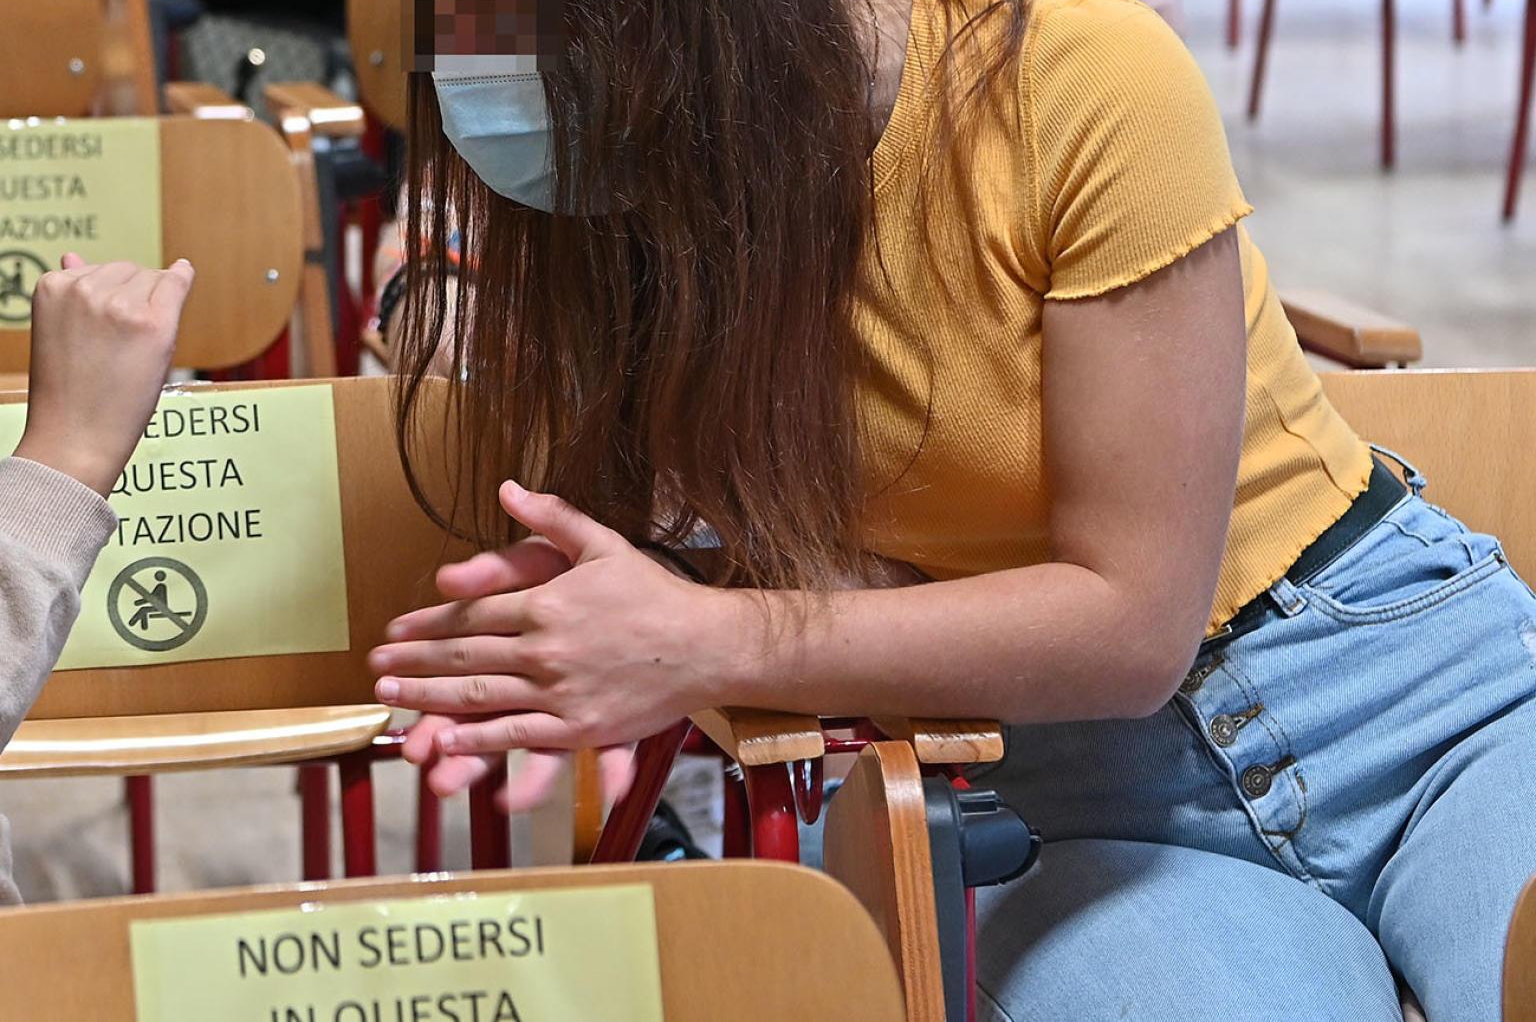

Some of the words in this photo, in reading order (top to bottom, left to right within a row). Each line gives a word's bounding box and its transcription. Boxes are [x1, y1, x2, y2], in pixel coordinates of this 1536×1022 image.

[144, 403, 260, 439] EDERSI
[118, 509, 263, 547] TAZIONE
[237, 931, 342, 978] NON
[358, 915, 545, 969] SEDERSI
